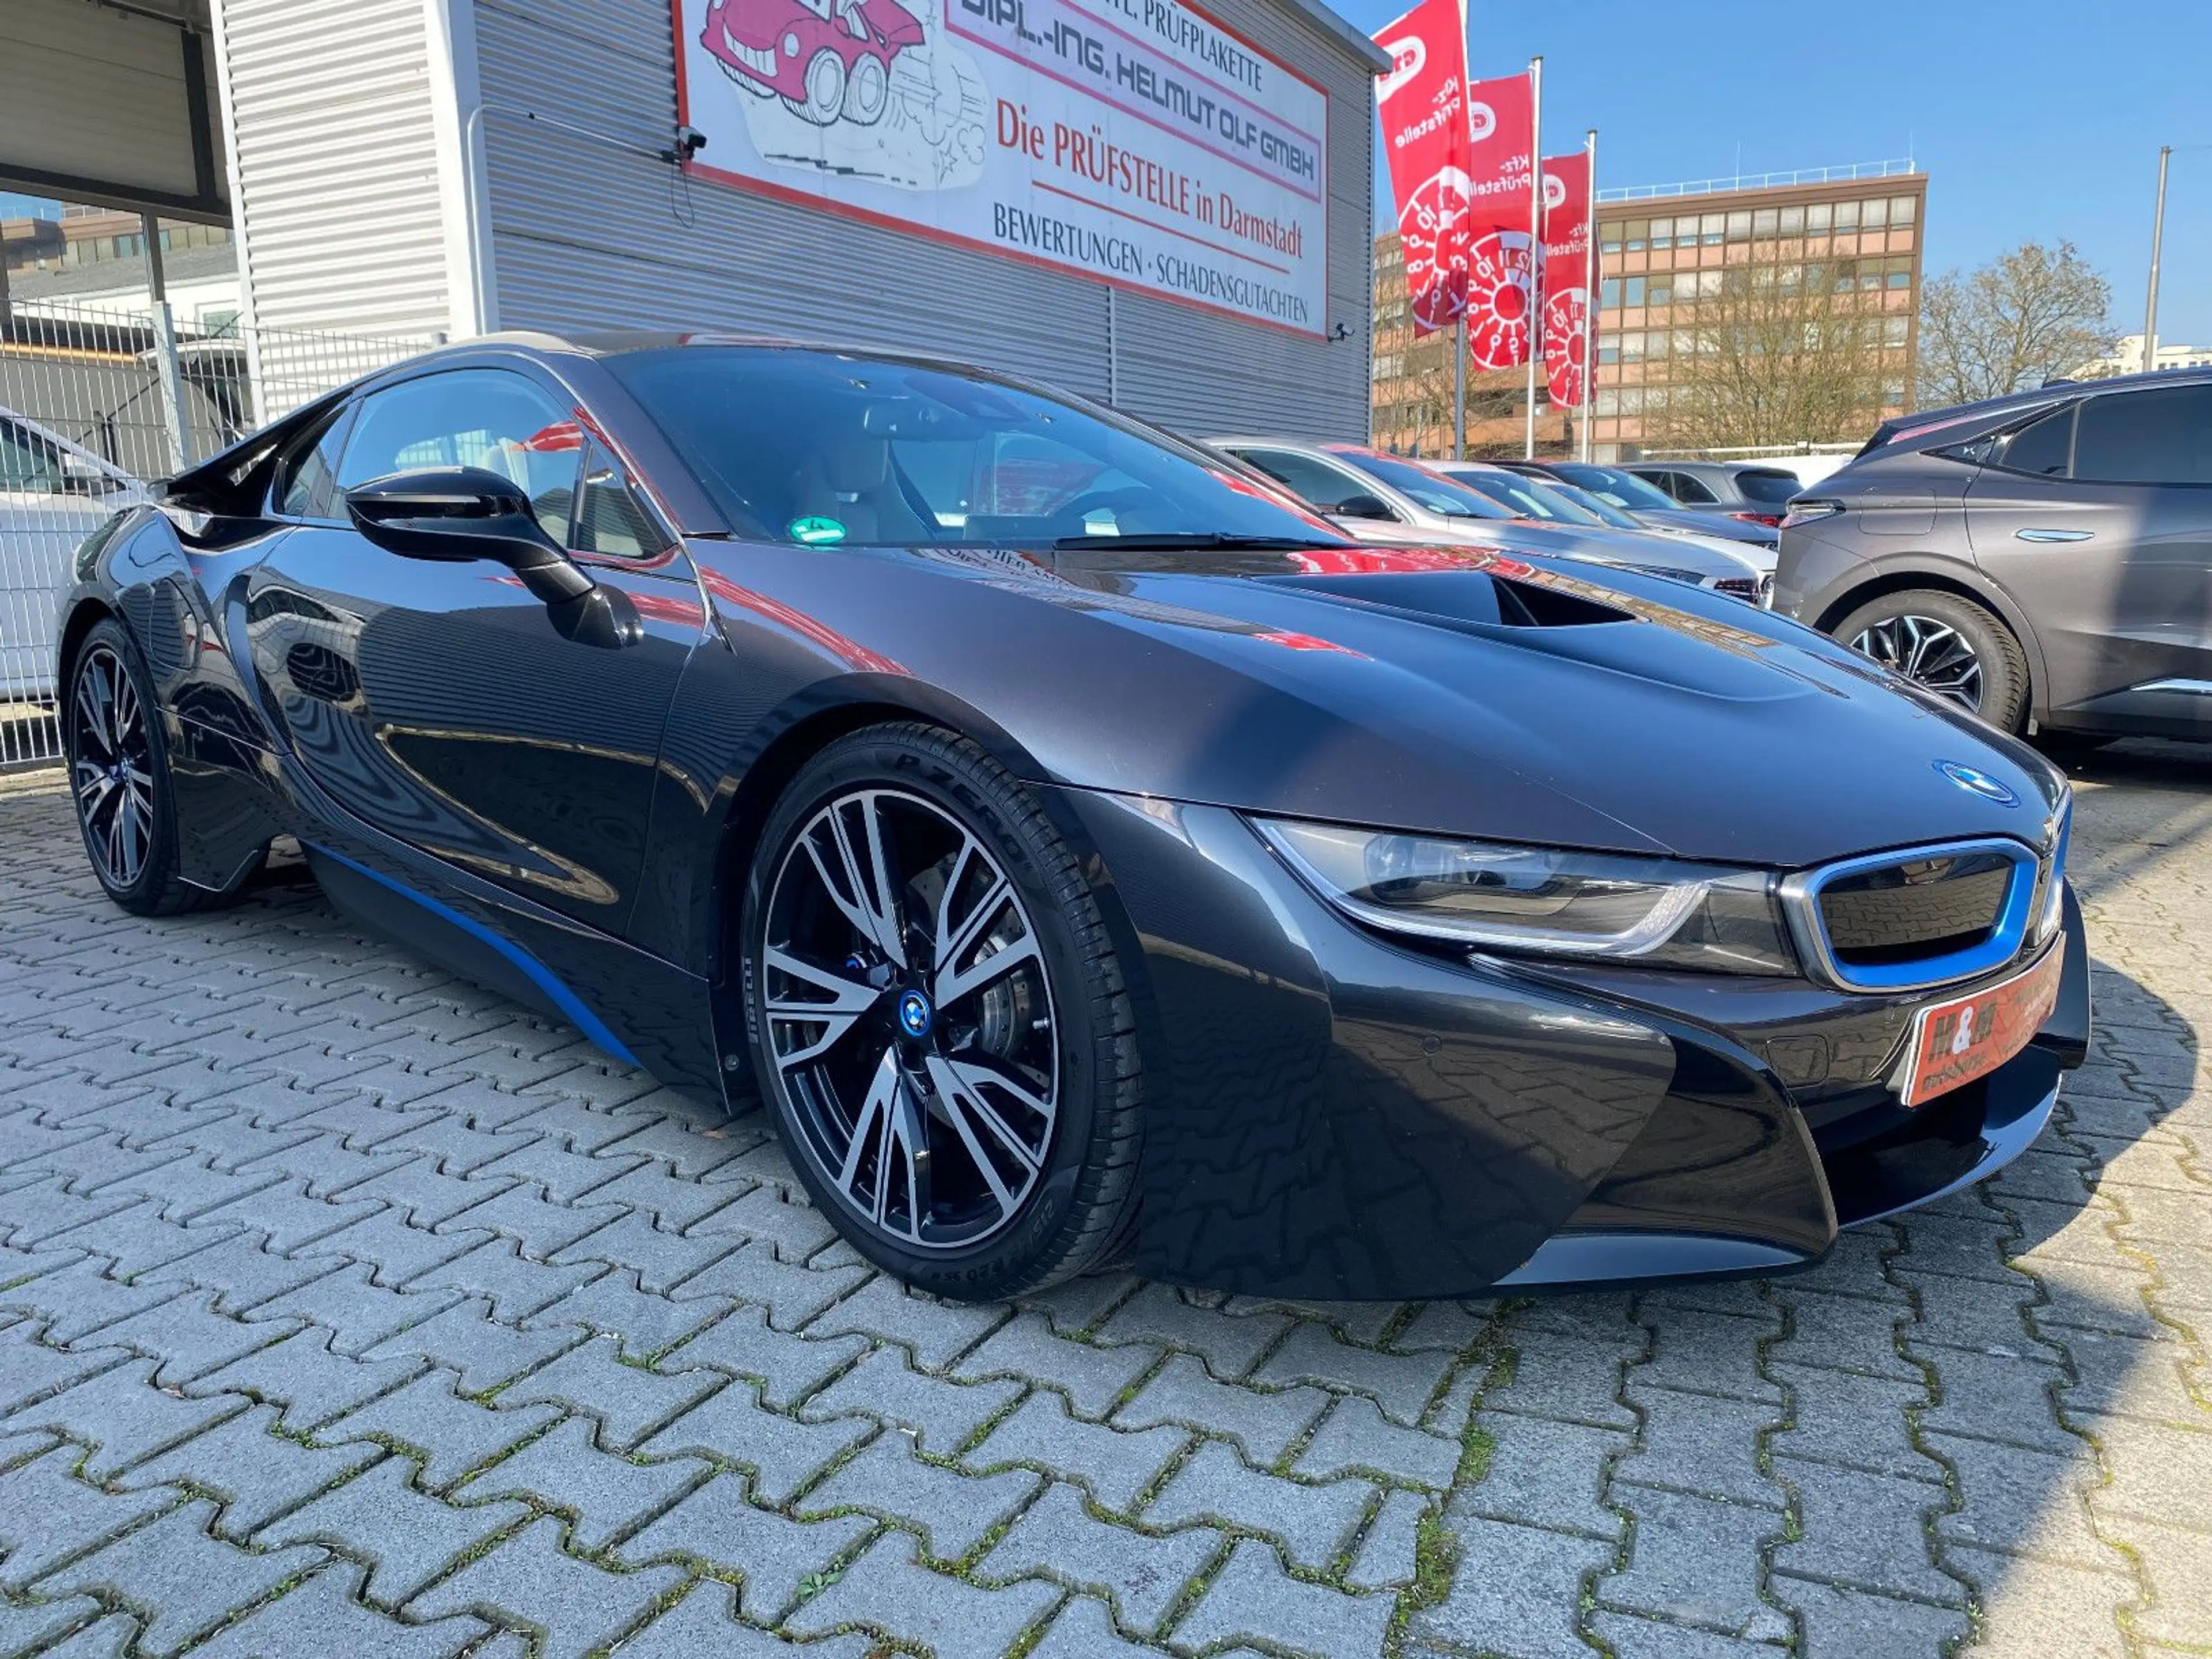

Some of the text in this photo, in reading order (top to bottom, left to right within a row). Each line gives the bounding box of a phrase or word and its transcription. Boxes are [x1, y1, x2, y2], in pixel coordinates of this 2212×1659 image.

[1117, 52, 1215, 130] HELMUT
[1219, 107, 1257, 149] OLF
[1145, 0, 1262, 92] PRÜFPLAKETTE
[997, 97, 1302, 259] Die PRÜFSTELLE in Darmstadt
[994, 202, 1308, 324] BEWERTUNGEN SCHADENSGUTACHTEN
